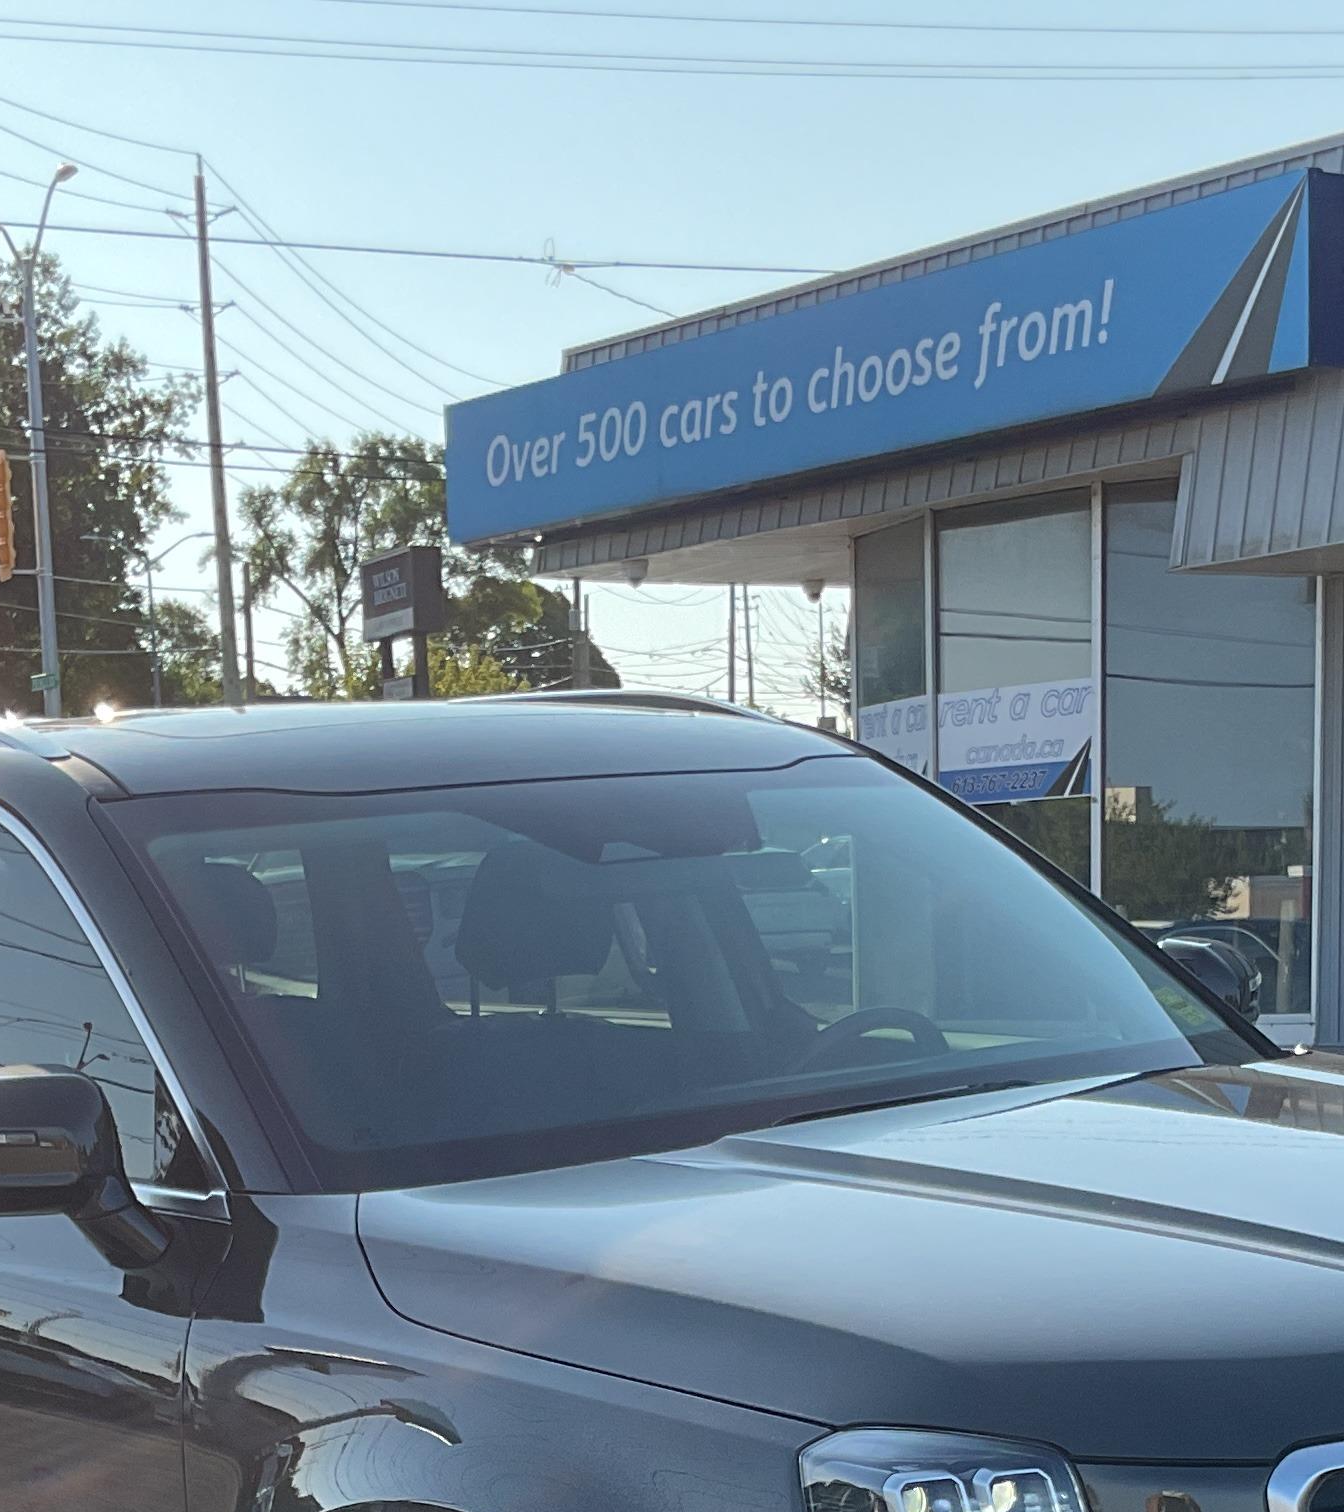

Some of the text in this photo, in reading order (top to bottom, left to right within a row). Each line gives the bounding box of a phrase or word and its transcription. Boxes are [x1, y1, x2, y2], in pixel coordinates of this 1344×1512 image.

[486, 278, 1114, 487] Over 500 cars to choose from!
[938, 685, 1093, 729] rent a car
[965, 733, 1065, 765] canada.ca
[951, 768, 1049, 796] 613-767-2237
